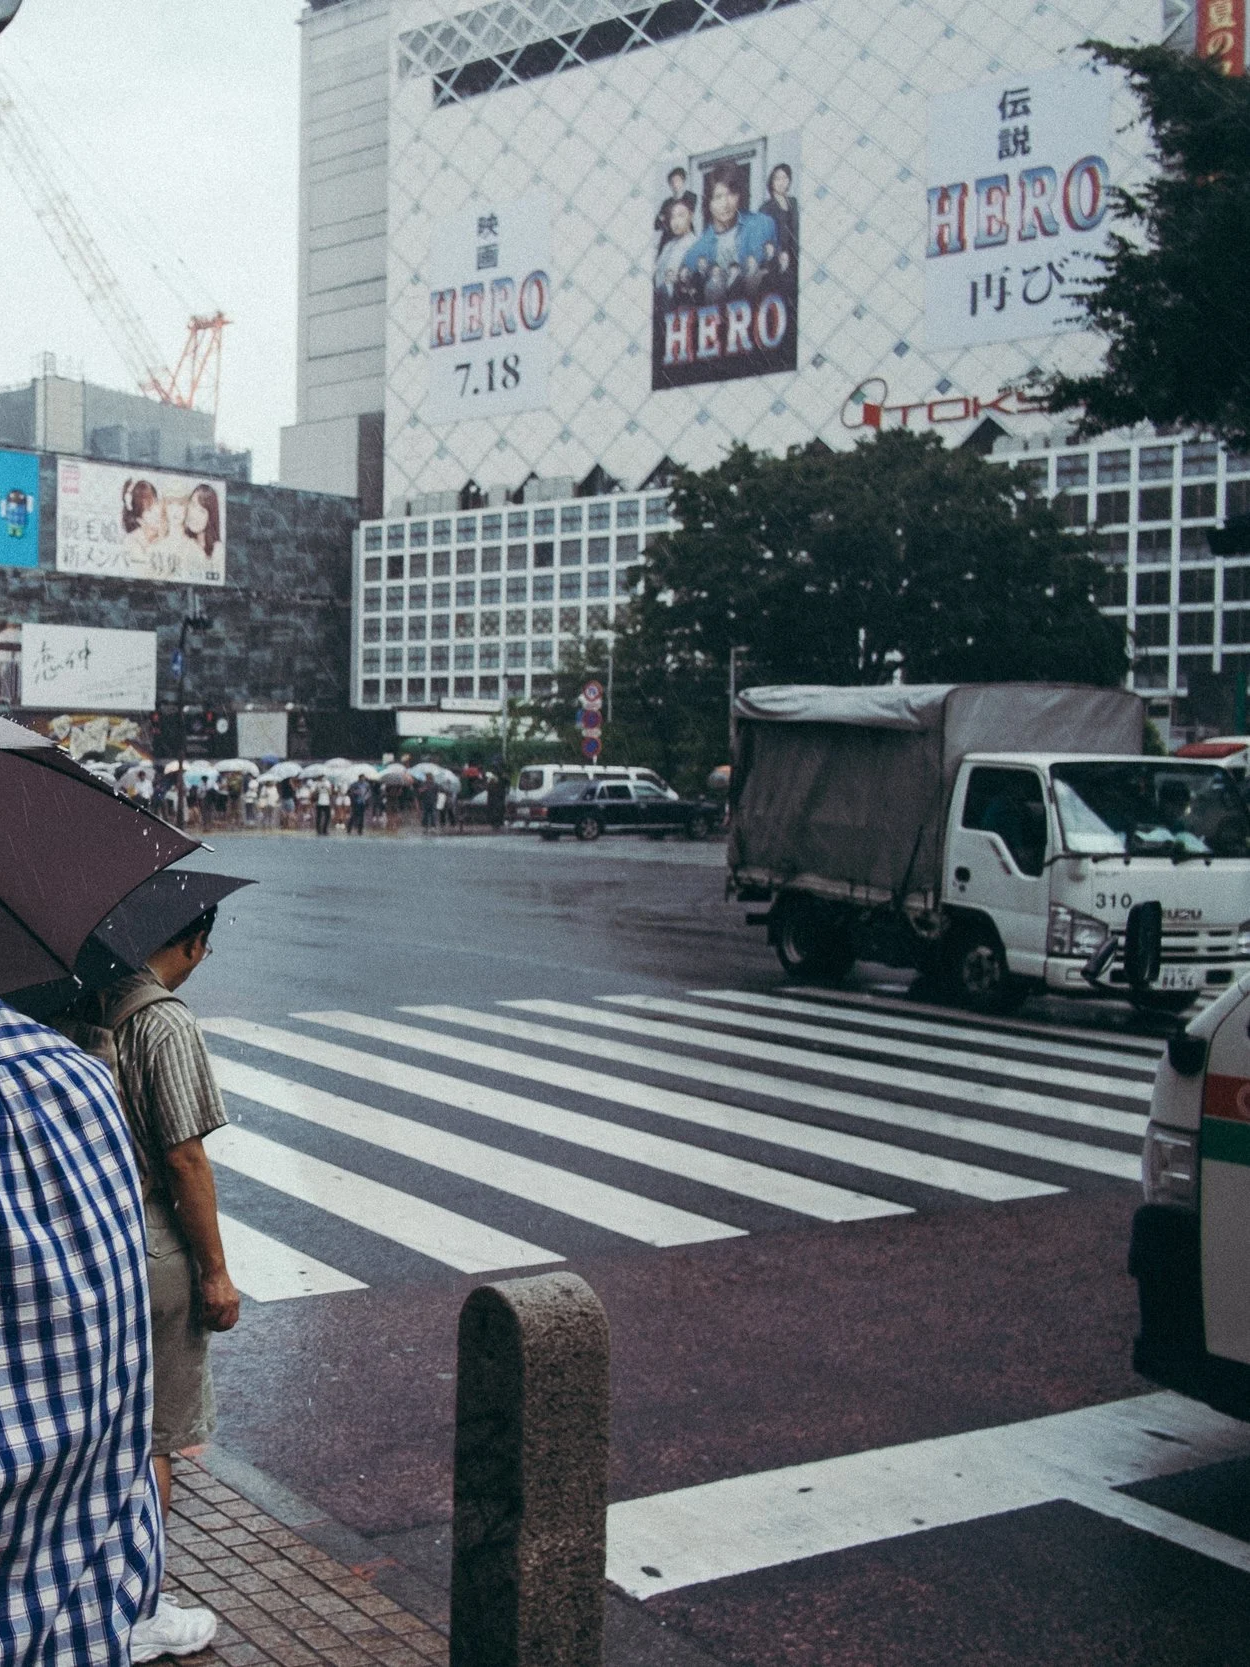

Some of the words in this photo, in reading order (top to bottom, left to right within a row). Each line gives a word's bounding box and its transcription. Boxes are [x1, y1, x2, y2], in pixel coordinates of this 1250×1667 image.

[998, 87, 1031, 159] 伝説
[476, 213, 500, 270] 映画
[926, 155, 1110, 259] HERO
[428, 269, 551, 350] HERO
[662, 293, 788, 366] HERO
[453, 353, 521, 397] 7.18
[1095, 892, 1133, 909] 310
